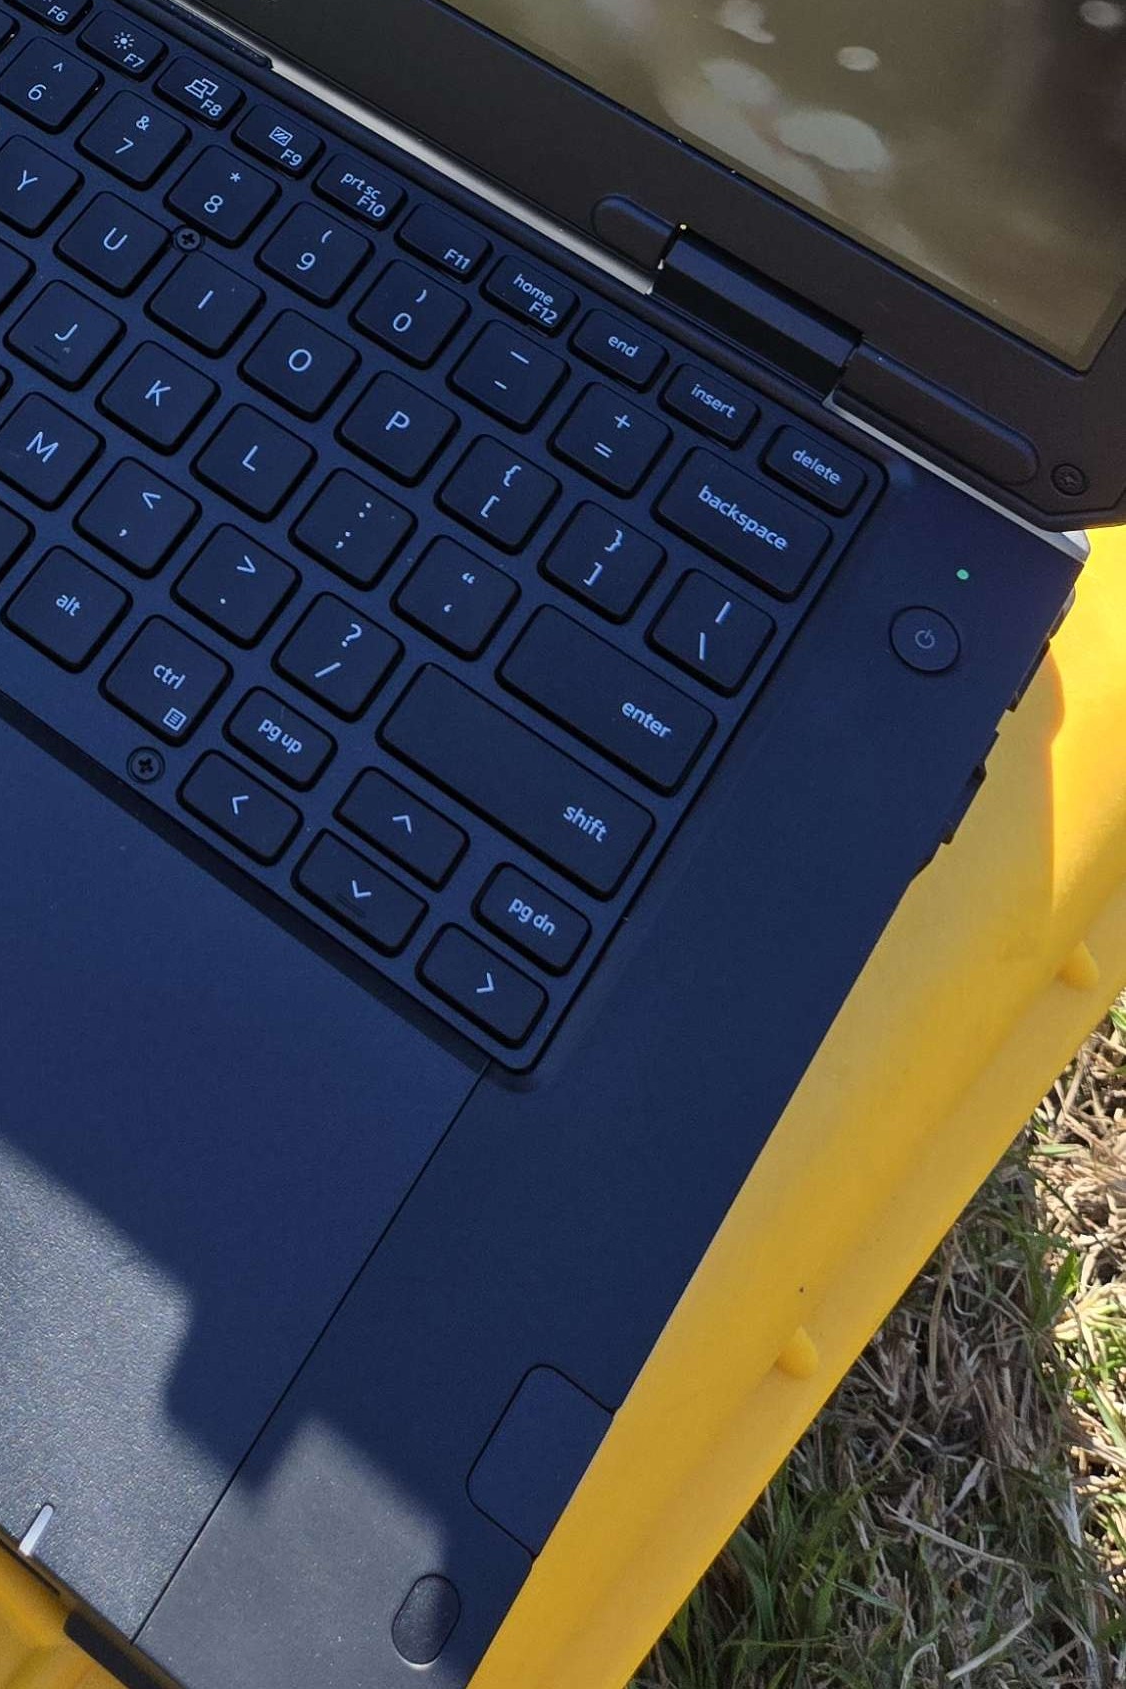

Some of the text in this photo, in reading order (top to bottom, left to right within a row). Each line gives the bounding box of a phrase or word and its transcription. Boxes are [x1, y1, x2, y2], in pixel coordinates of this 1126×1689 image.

[47, 5, 69, 22] F6
[123, 52, 145, 68] F7
[27, 83, 47, 101] 6
[200, 98, 223, 117] F8
[135, 115, 150, 131] &
[115, 137, 134, 154] 7
[280, 148, 303, 166] F9
[17, 169, 38, 191] Y
[340, 173, 381, 200] prt sc
[203, 194, 224, 214] 8
[356, 195, 386, 217] F10
[103, 227, 128, 251] U
[296, 252, 316, 271] 9
[443, 248, 471, 270] F11
[512, 273, 554, 305] home
[528, 301, 559, 324] F12
[54, 323, 78, 341] J
[608, 336, 640, 358] end
[288, 348, 313, 372] O
[144, 379, 171, 407] K
[691, 383, 736, 419] insert
[385, 410, 411, 431] P
[25, 431, 59, 463] M
[241, 445, 259, 472] L
[792, 449, 841, 485] delete
[698, 484, 788, 551] backspace
[55, 594, 81, 617] alt
[341, 623, 363, 648] ?
[153, 664, 186, 690] ctrl
[621, 702, 672, 738] enter
[258, 719, 302, 754] pg up
[563, 806, 607, 843] shift
[508, 898, 556, 936] pg dn
